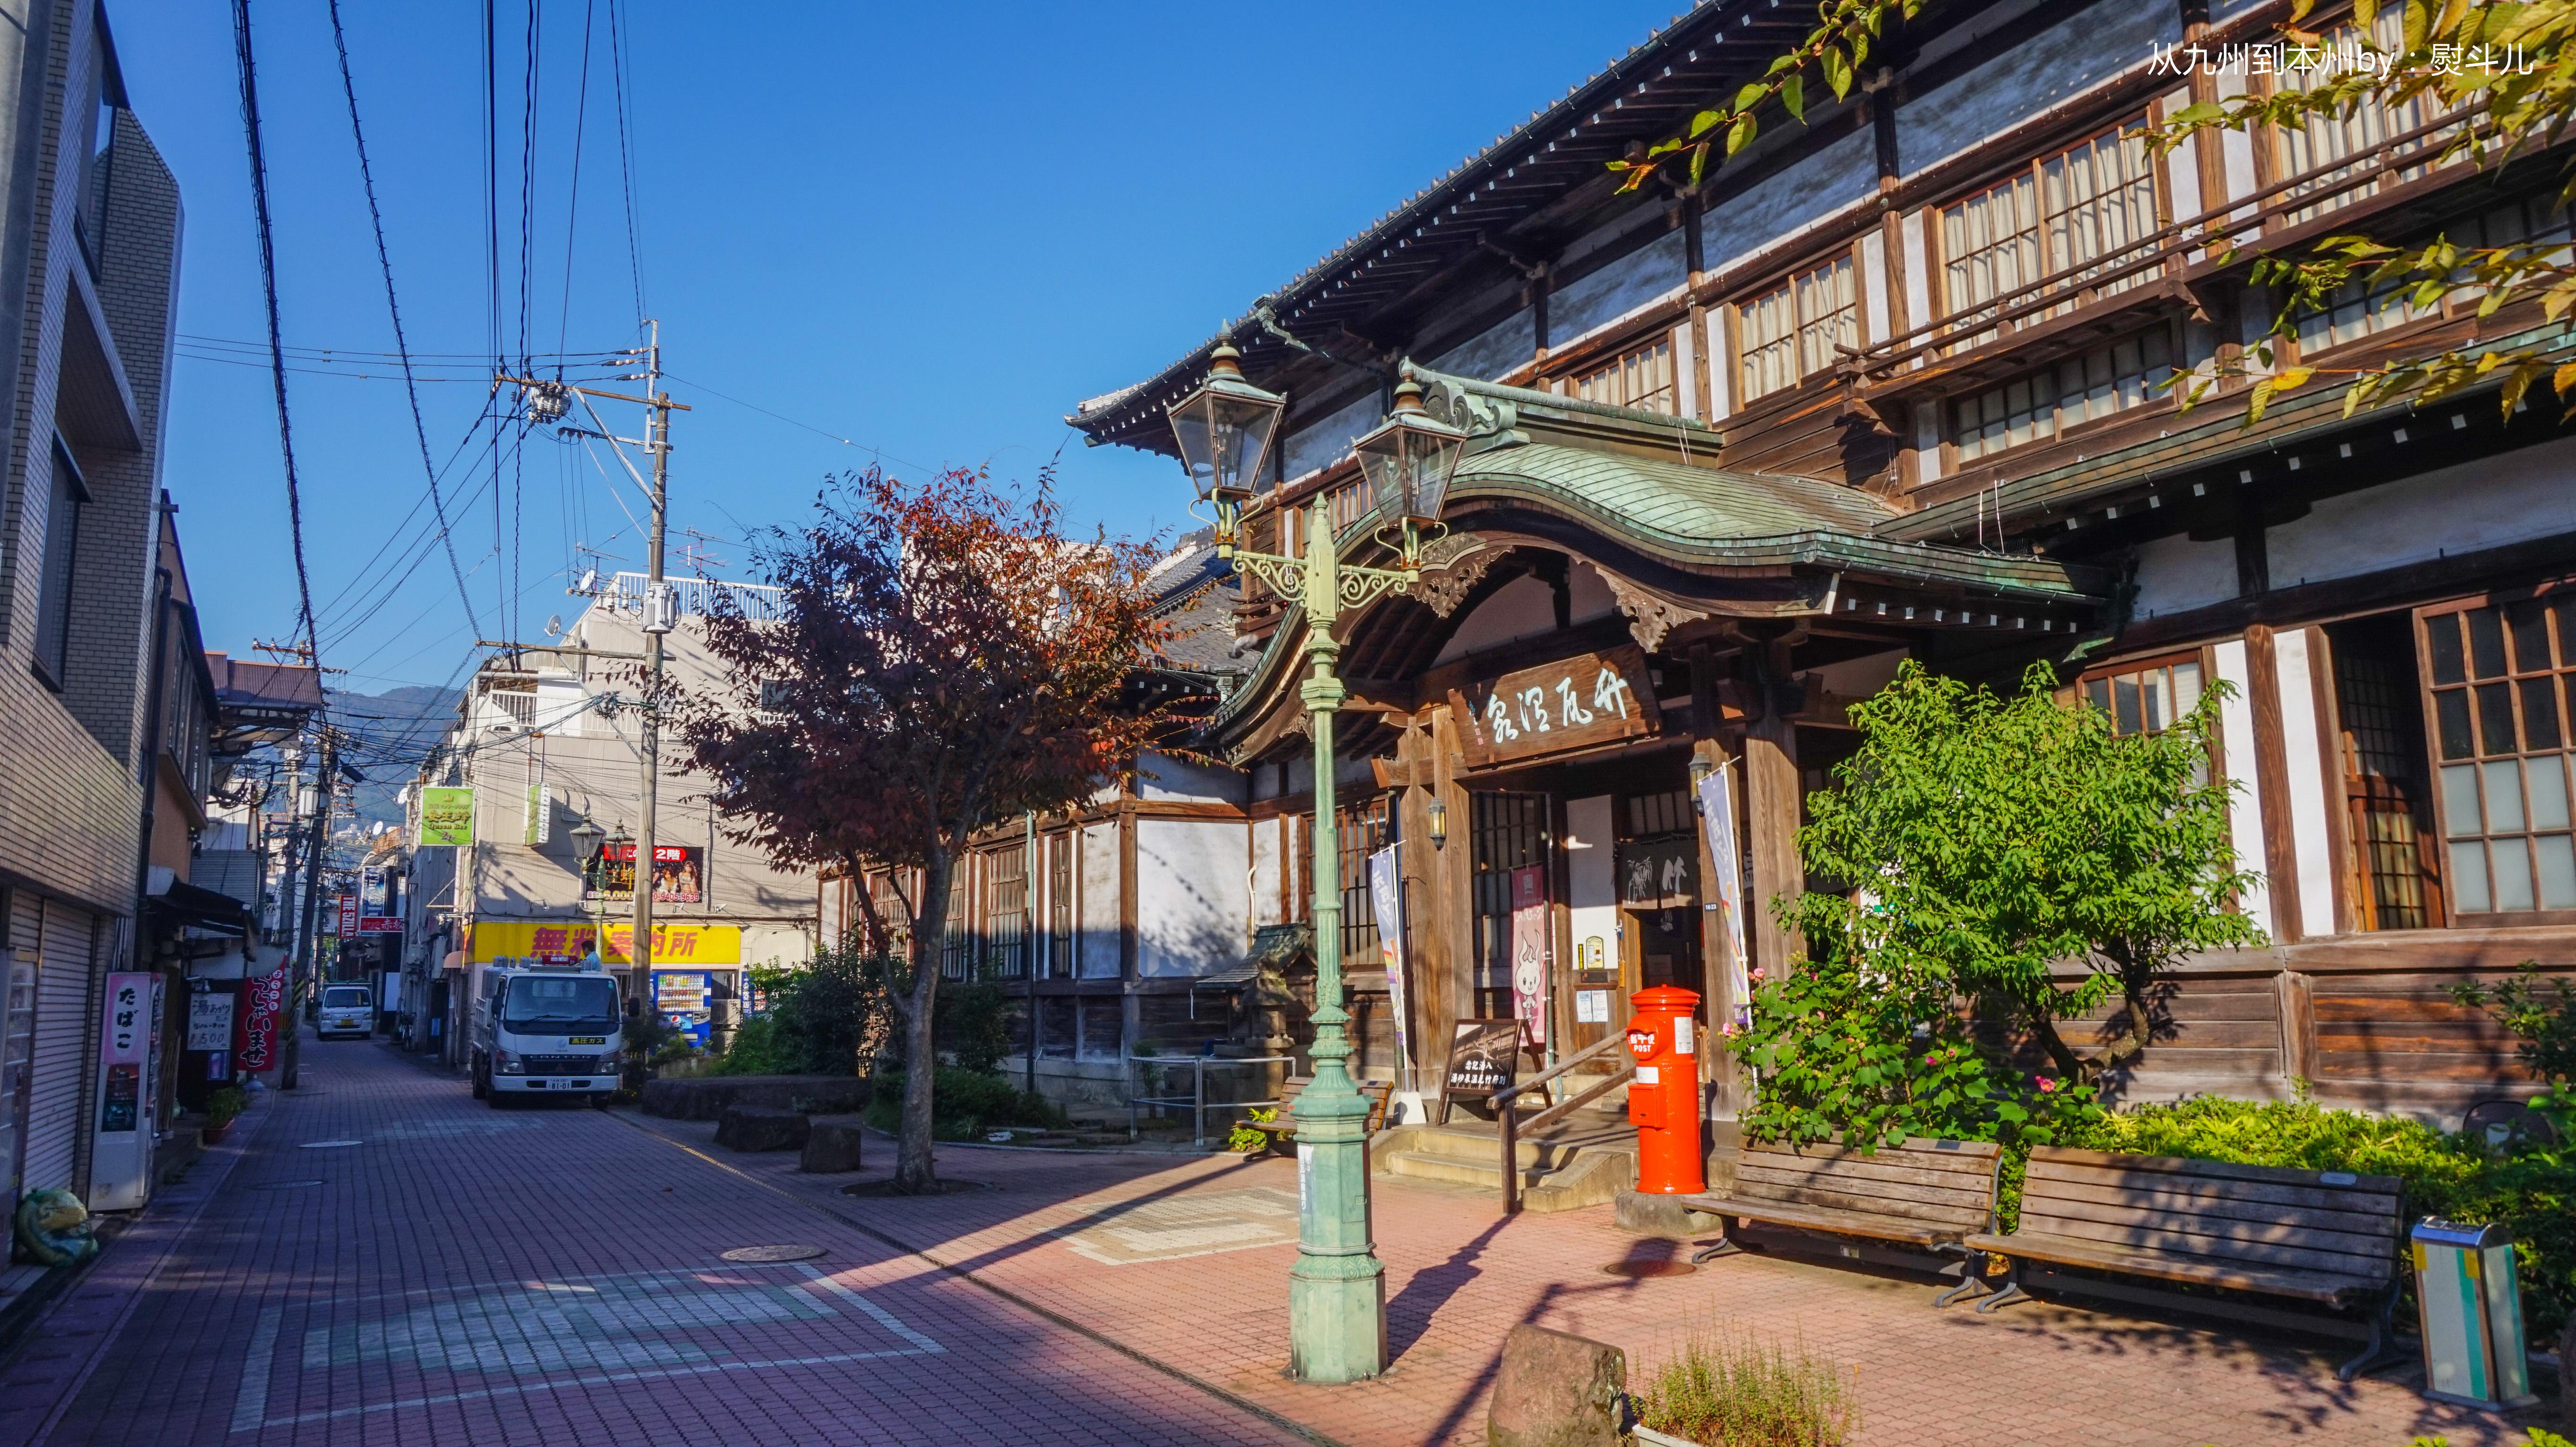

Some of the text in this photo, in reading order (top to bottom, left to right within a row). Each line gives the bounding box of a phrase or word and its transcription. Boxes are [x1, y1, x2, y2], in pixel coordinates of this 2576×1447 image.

[656, 849, 680, 860] 2階
[343, 896, 356, 911] THE
[117, 988, 139, 1049] たばこ
